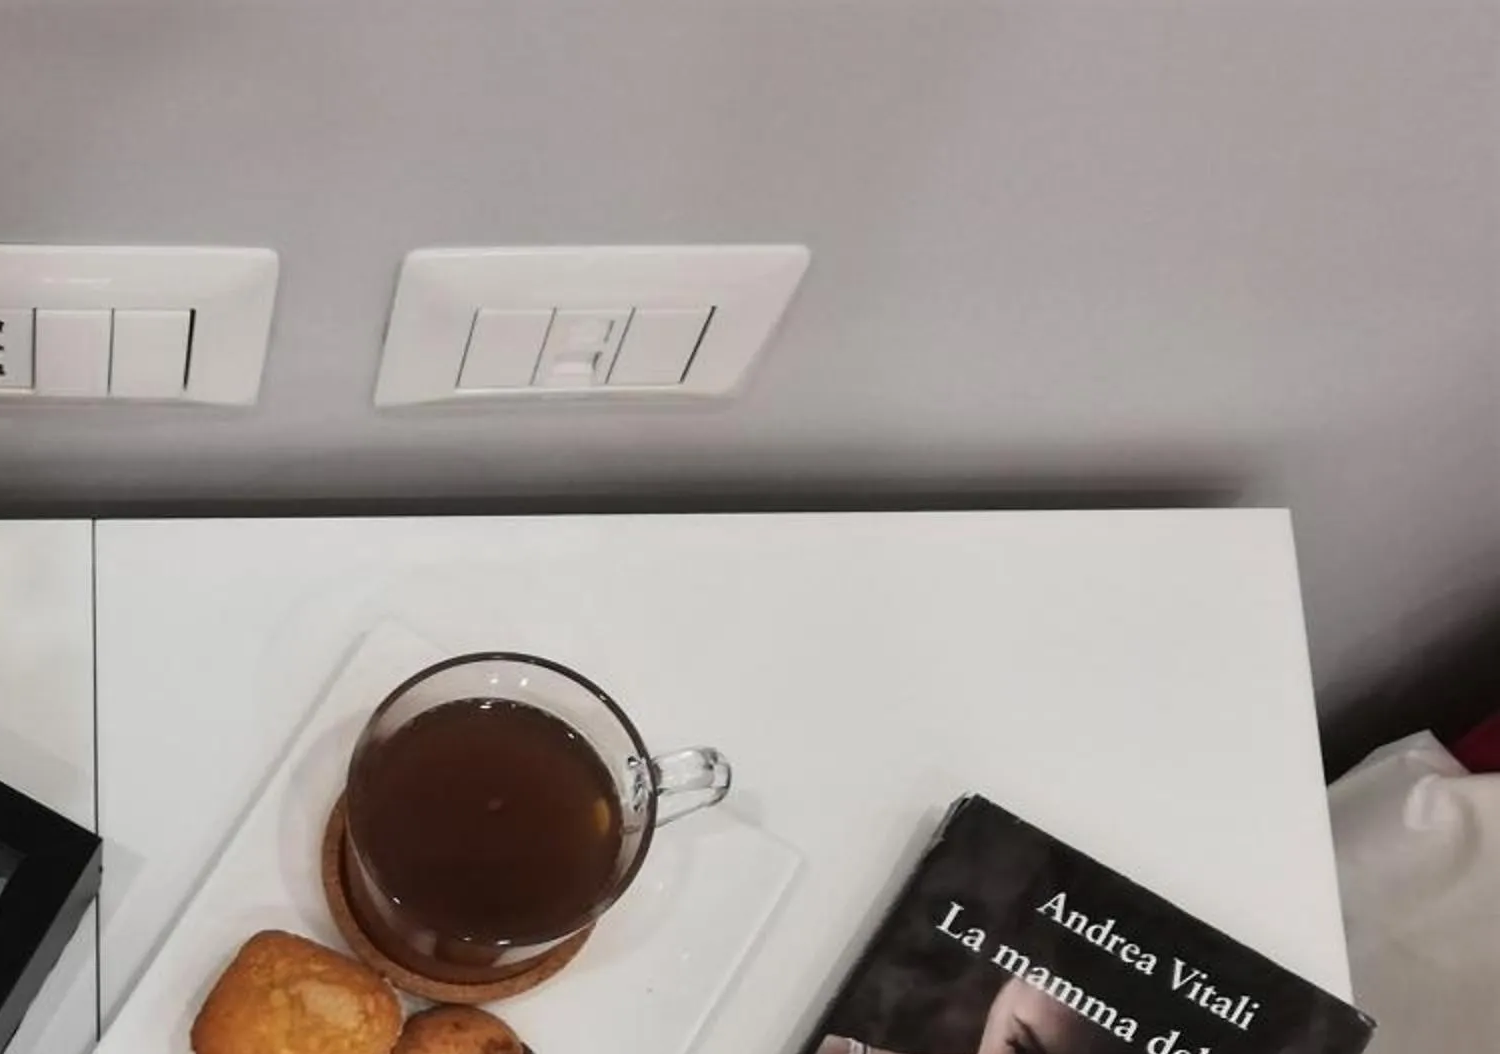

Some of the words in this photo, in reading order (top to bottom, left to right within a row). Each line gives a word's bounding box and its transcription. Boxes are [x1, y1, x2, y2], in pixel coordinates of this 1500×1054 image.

[935, 902, 987, 952] La
[991, 944, 1139, 1043] mamma
[1037, 891, 1157, 976] Andrea
[1171, 958, 1260, 1031] Vitali
